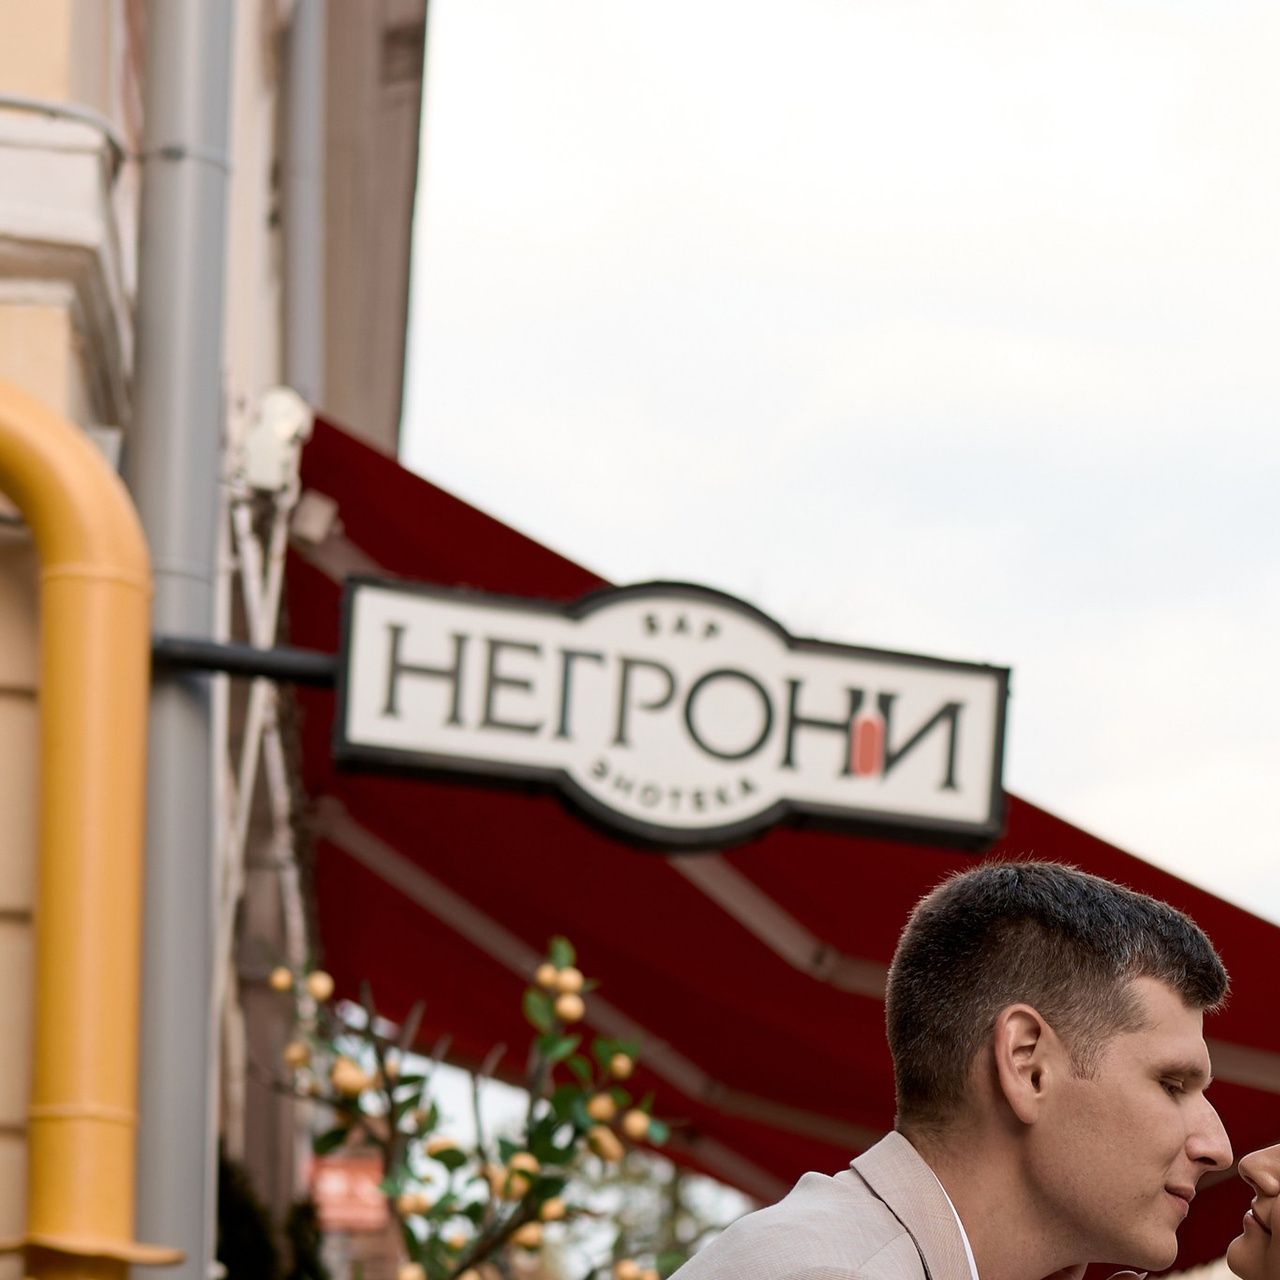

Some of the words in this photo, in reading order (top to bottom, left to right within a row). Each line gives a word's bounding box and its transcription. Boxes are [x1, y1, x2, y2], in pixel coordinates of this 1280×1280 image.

[643, 612, 721, 638] БАР
[379, 622, 966, 792] НЕГРОНИ
[591, 757, 758, 812] ЭНОТЕКА
